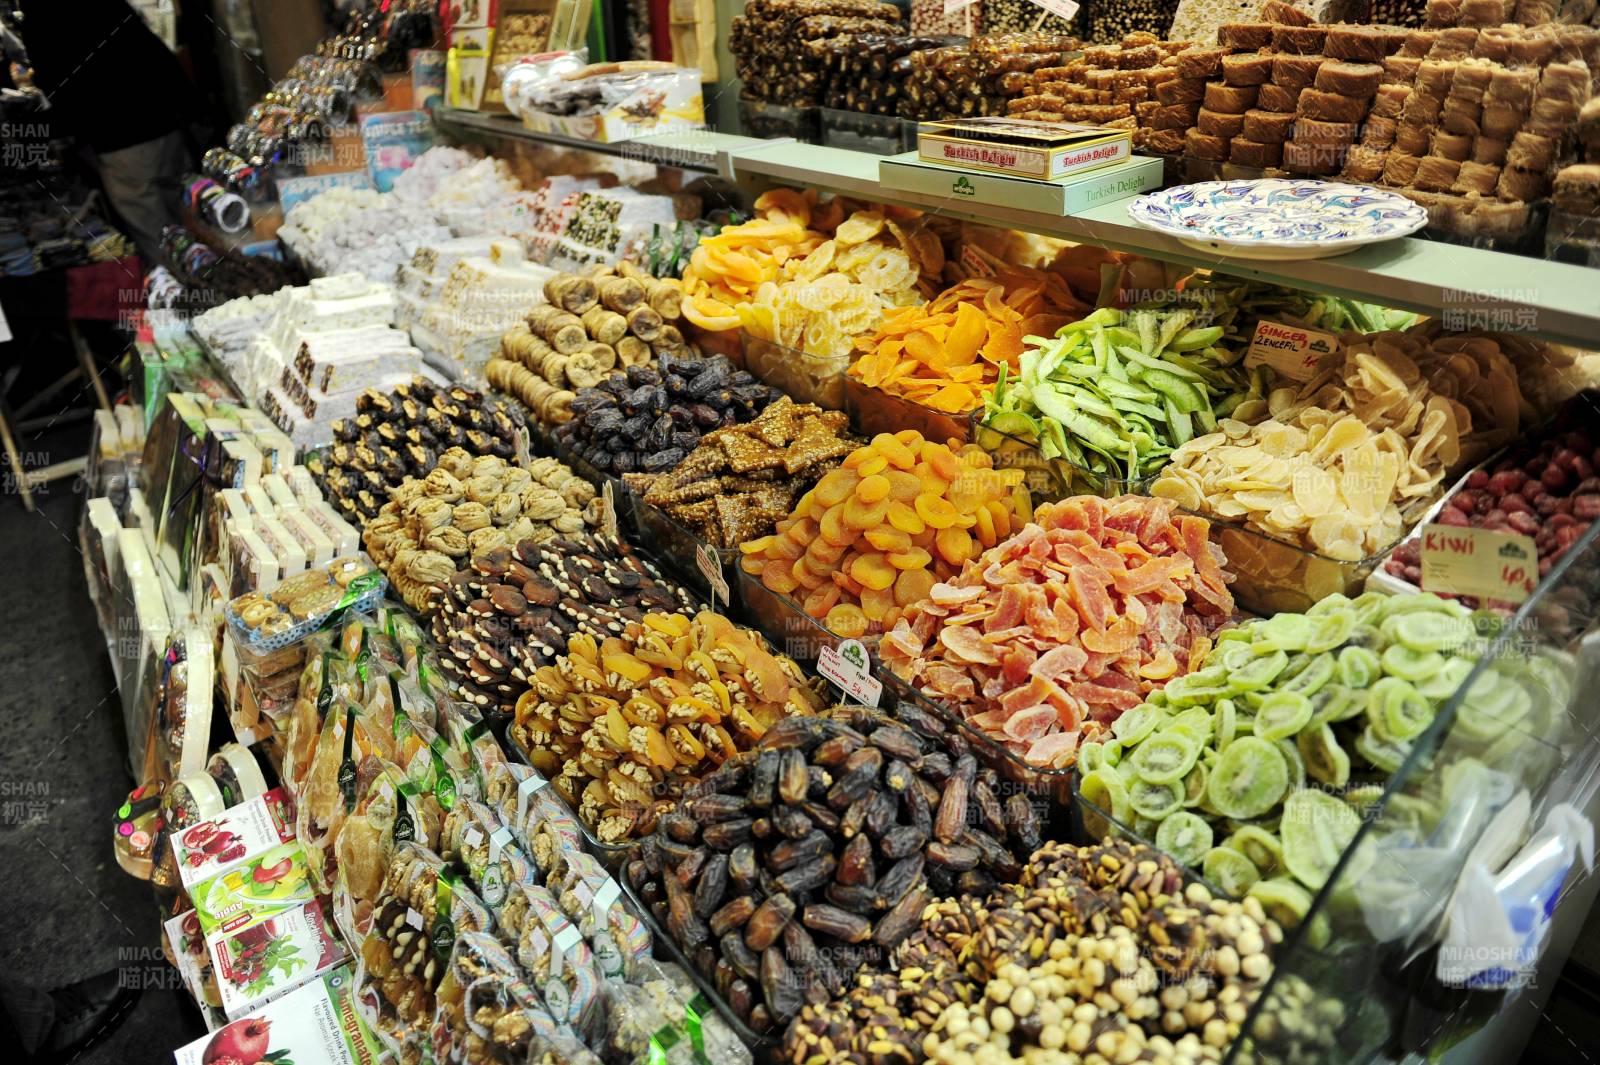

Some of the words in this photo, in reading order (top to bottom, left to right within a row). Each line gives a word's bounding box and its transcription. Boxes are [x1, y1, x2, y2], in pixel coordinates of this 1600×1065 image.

[943, 144, 980, 161] Turkish
[980, 148, 1016, 167] Delight
[1062, 152, 1092, 168] Turkish
[1092, 146, 1119, 162] Delight
[1085, 185, 1115, 203] Turkish
[1117, 175, 1146, 196] Delight
[1258, 325, 1308, 348] GINGER
[213, 900, 244, 920] Apple
[320, 997, 336, 1030] Flavoured
[332, 1029, 344, 1049] Drink
[334, 986, 372, 1065] Pomegranate
